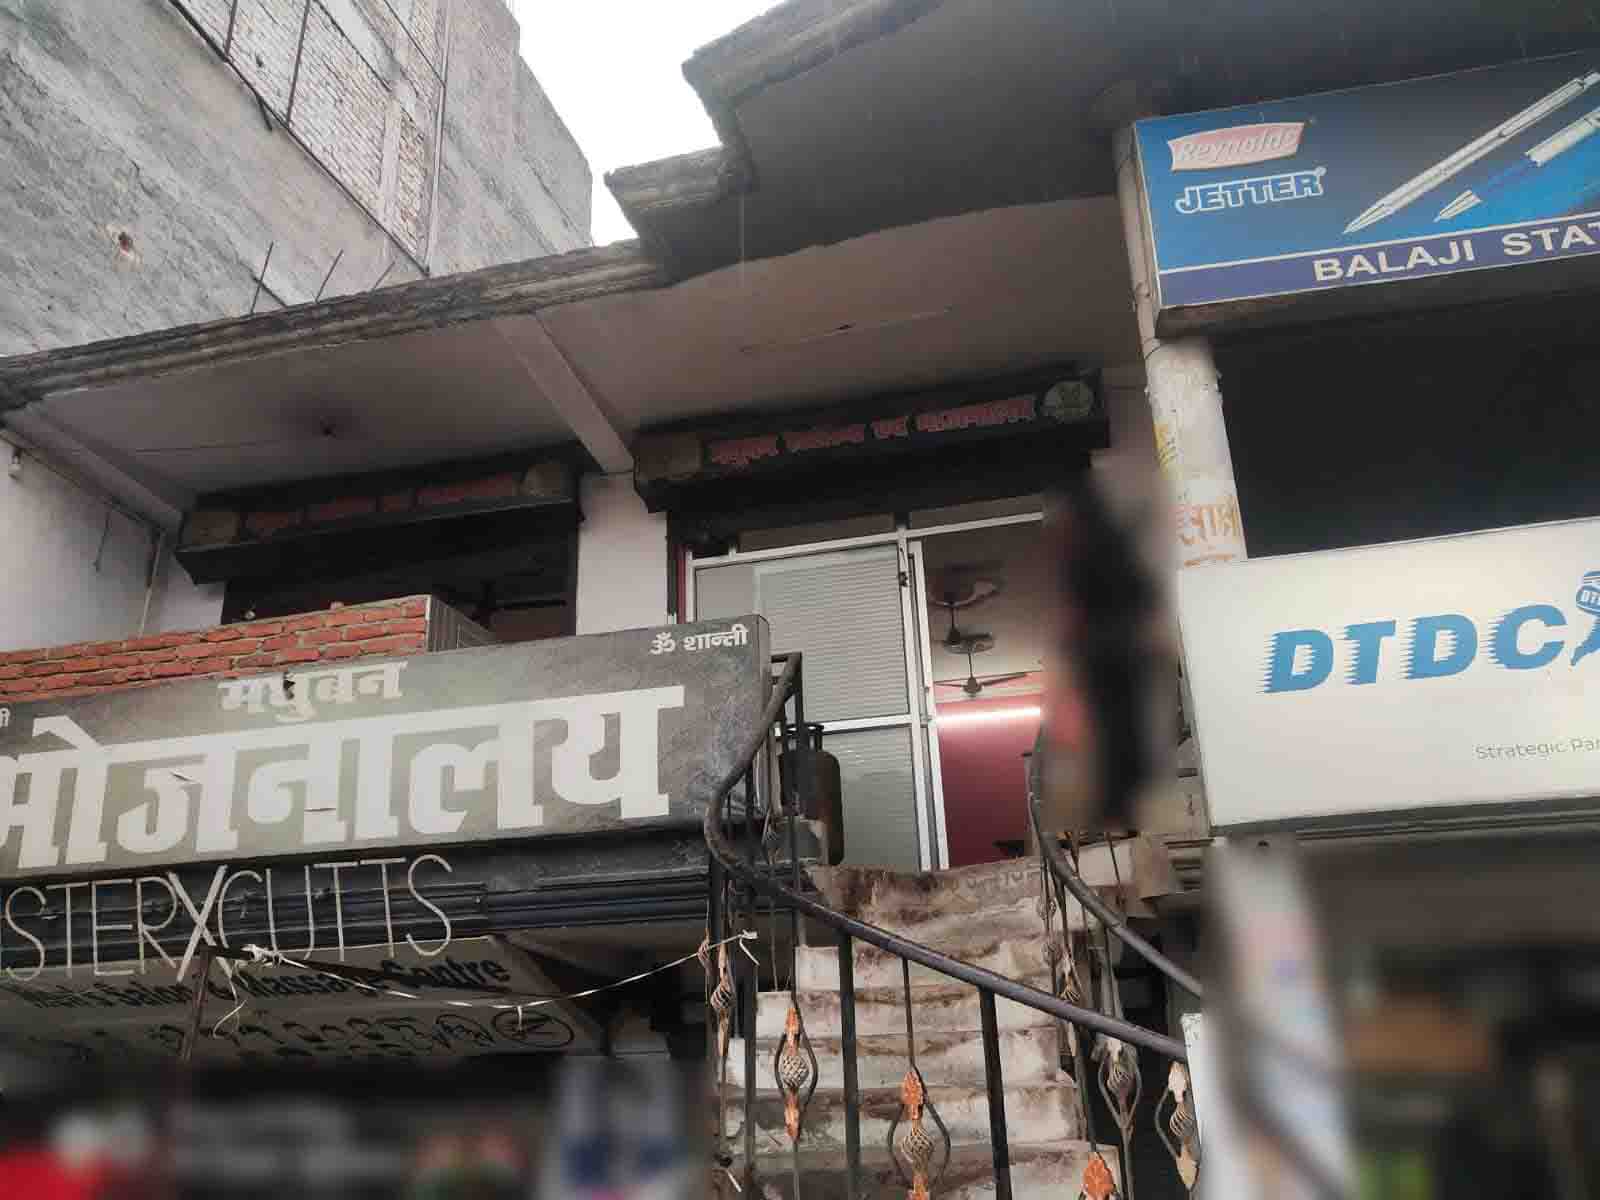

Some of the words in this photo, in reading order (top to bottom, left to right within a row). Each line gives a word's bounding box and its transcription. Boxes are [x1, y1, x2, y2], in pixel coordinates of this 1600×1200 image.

[1312, 239, 1475, 281] BALAJI
[1257, 604, 1567, 693] DTDC
[1475, 743, 1567, 760] Strategic
